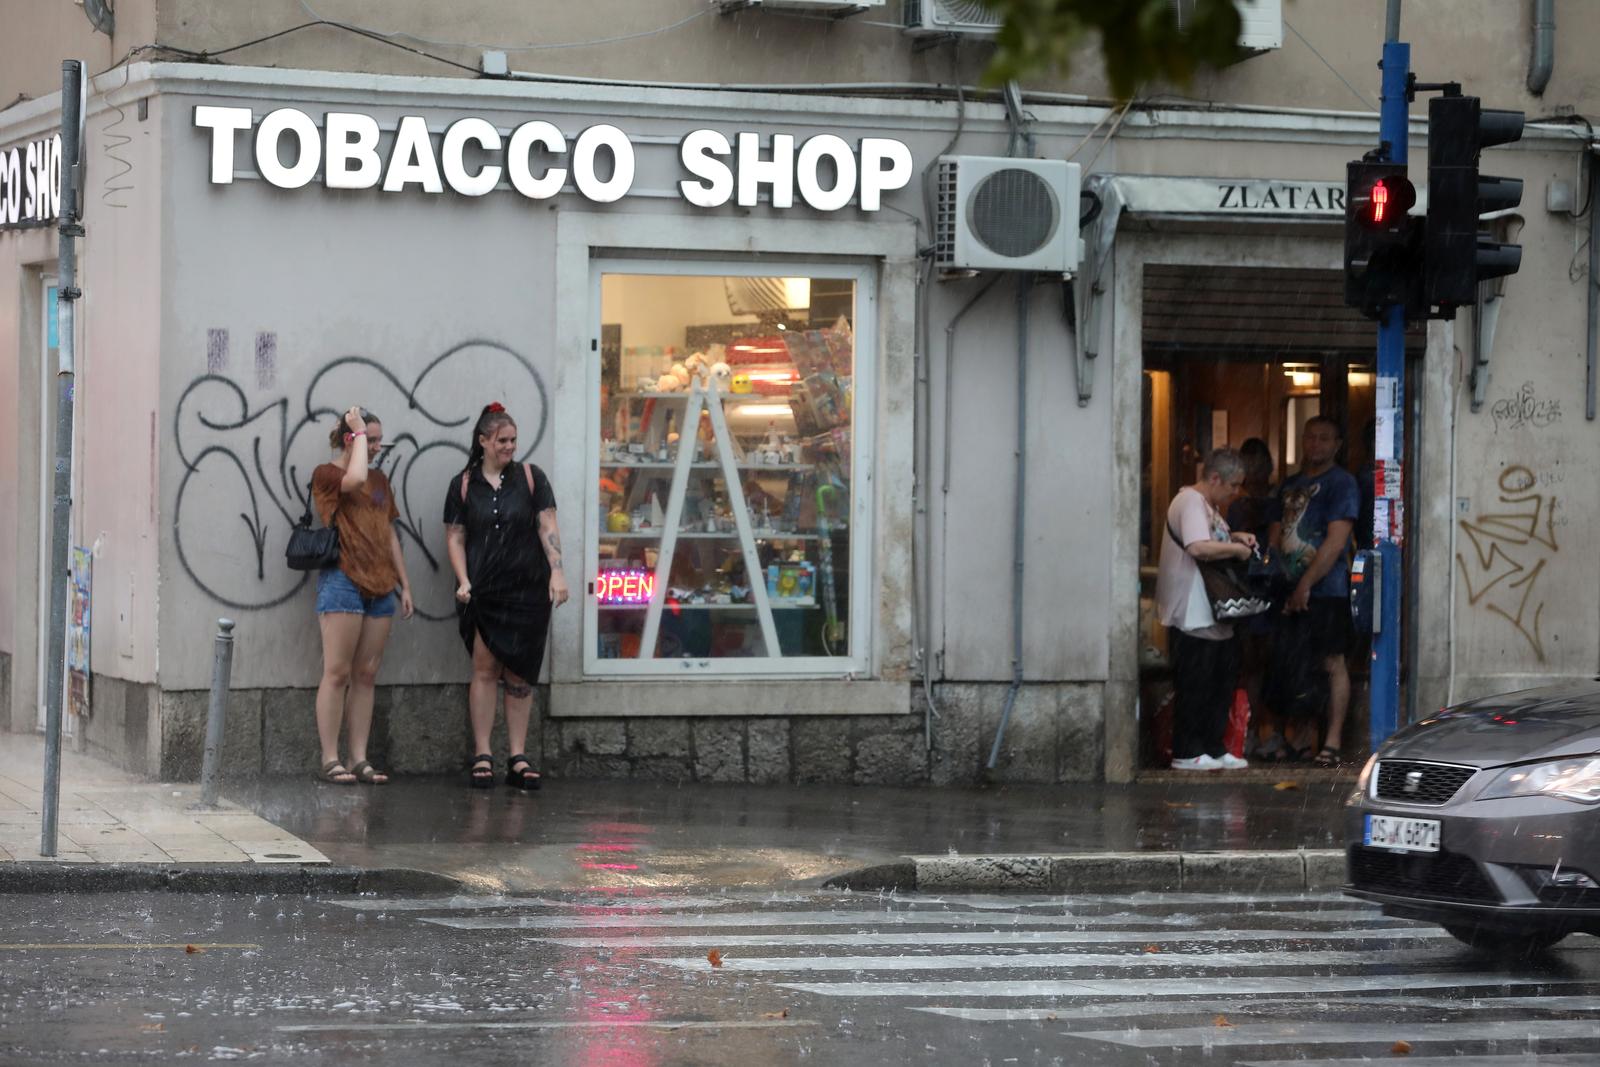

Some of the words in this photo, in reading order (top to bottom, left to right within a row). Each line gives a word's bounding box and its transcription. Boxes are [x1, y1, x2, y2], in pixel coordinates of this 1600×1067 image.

[194, 105, 636, 204] TOBACCO
[679, 129, 914, 212] SHOP
[596, 576, 653, 598] OPEN
